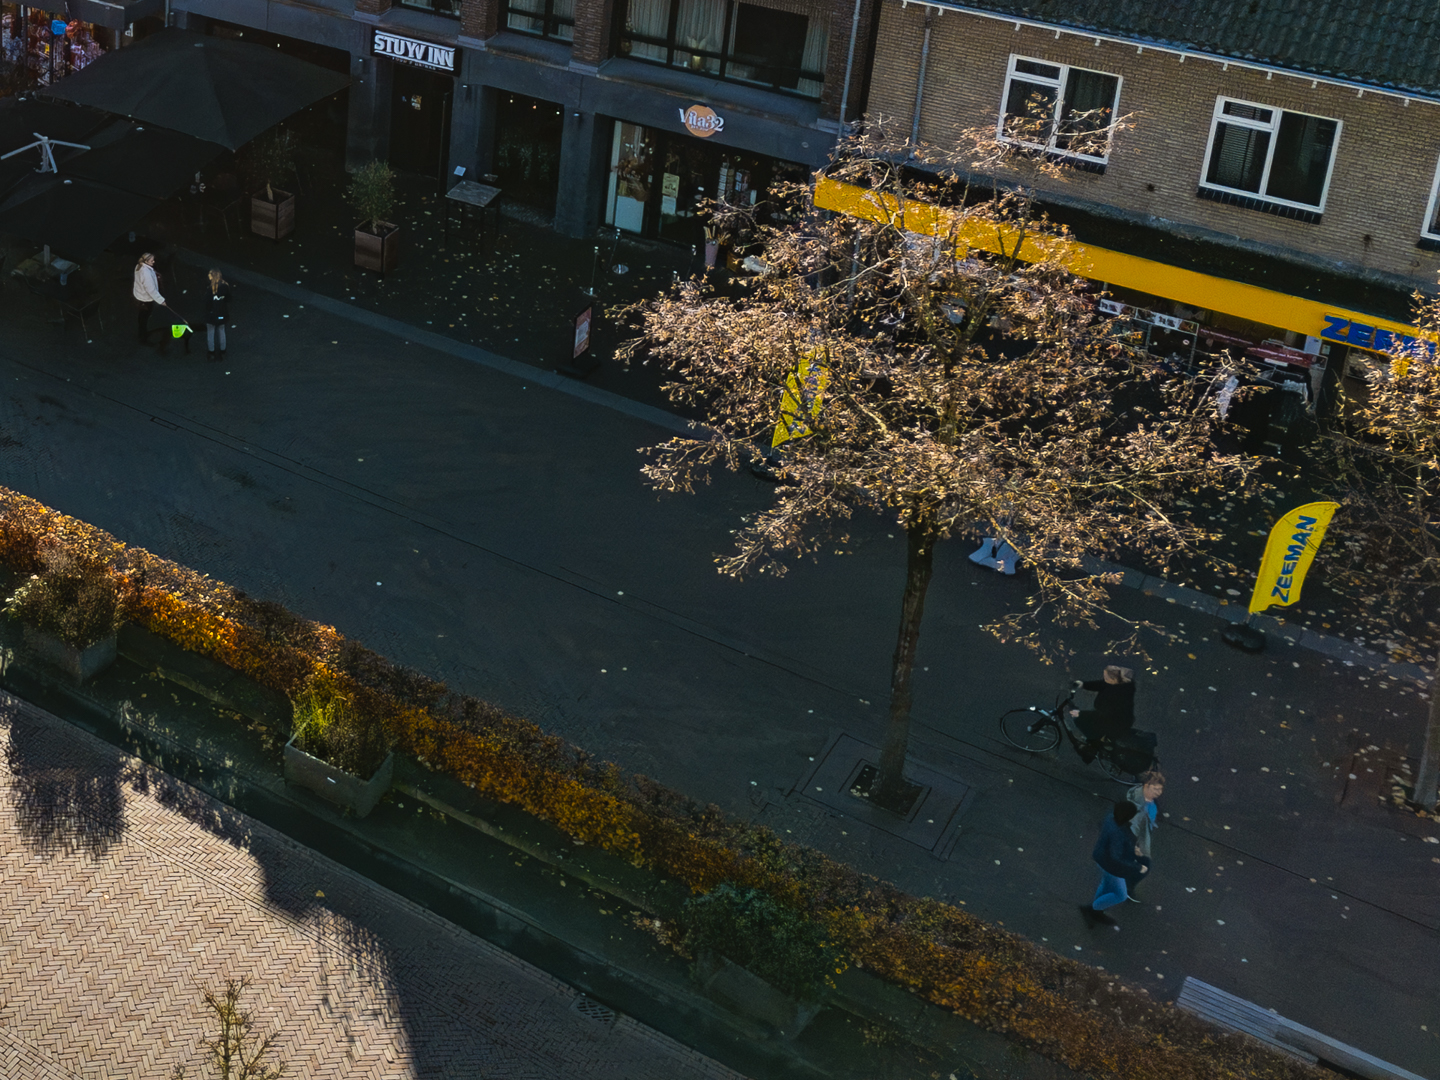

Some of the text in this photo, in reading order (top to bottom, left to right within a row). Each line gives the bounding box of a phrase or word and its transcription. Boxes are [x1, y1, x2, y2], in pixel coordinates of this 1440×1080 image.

[374, 34, 427, 60] STUYV
[427, 46, 455, 68] INN
[1270, 514, 1318, 603] ZEEMAN
